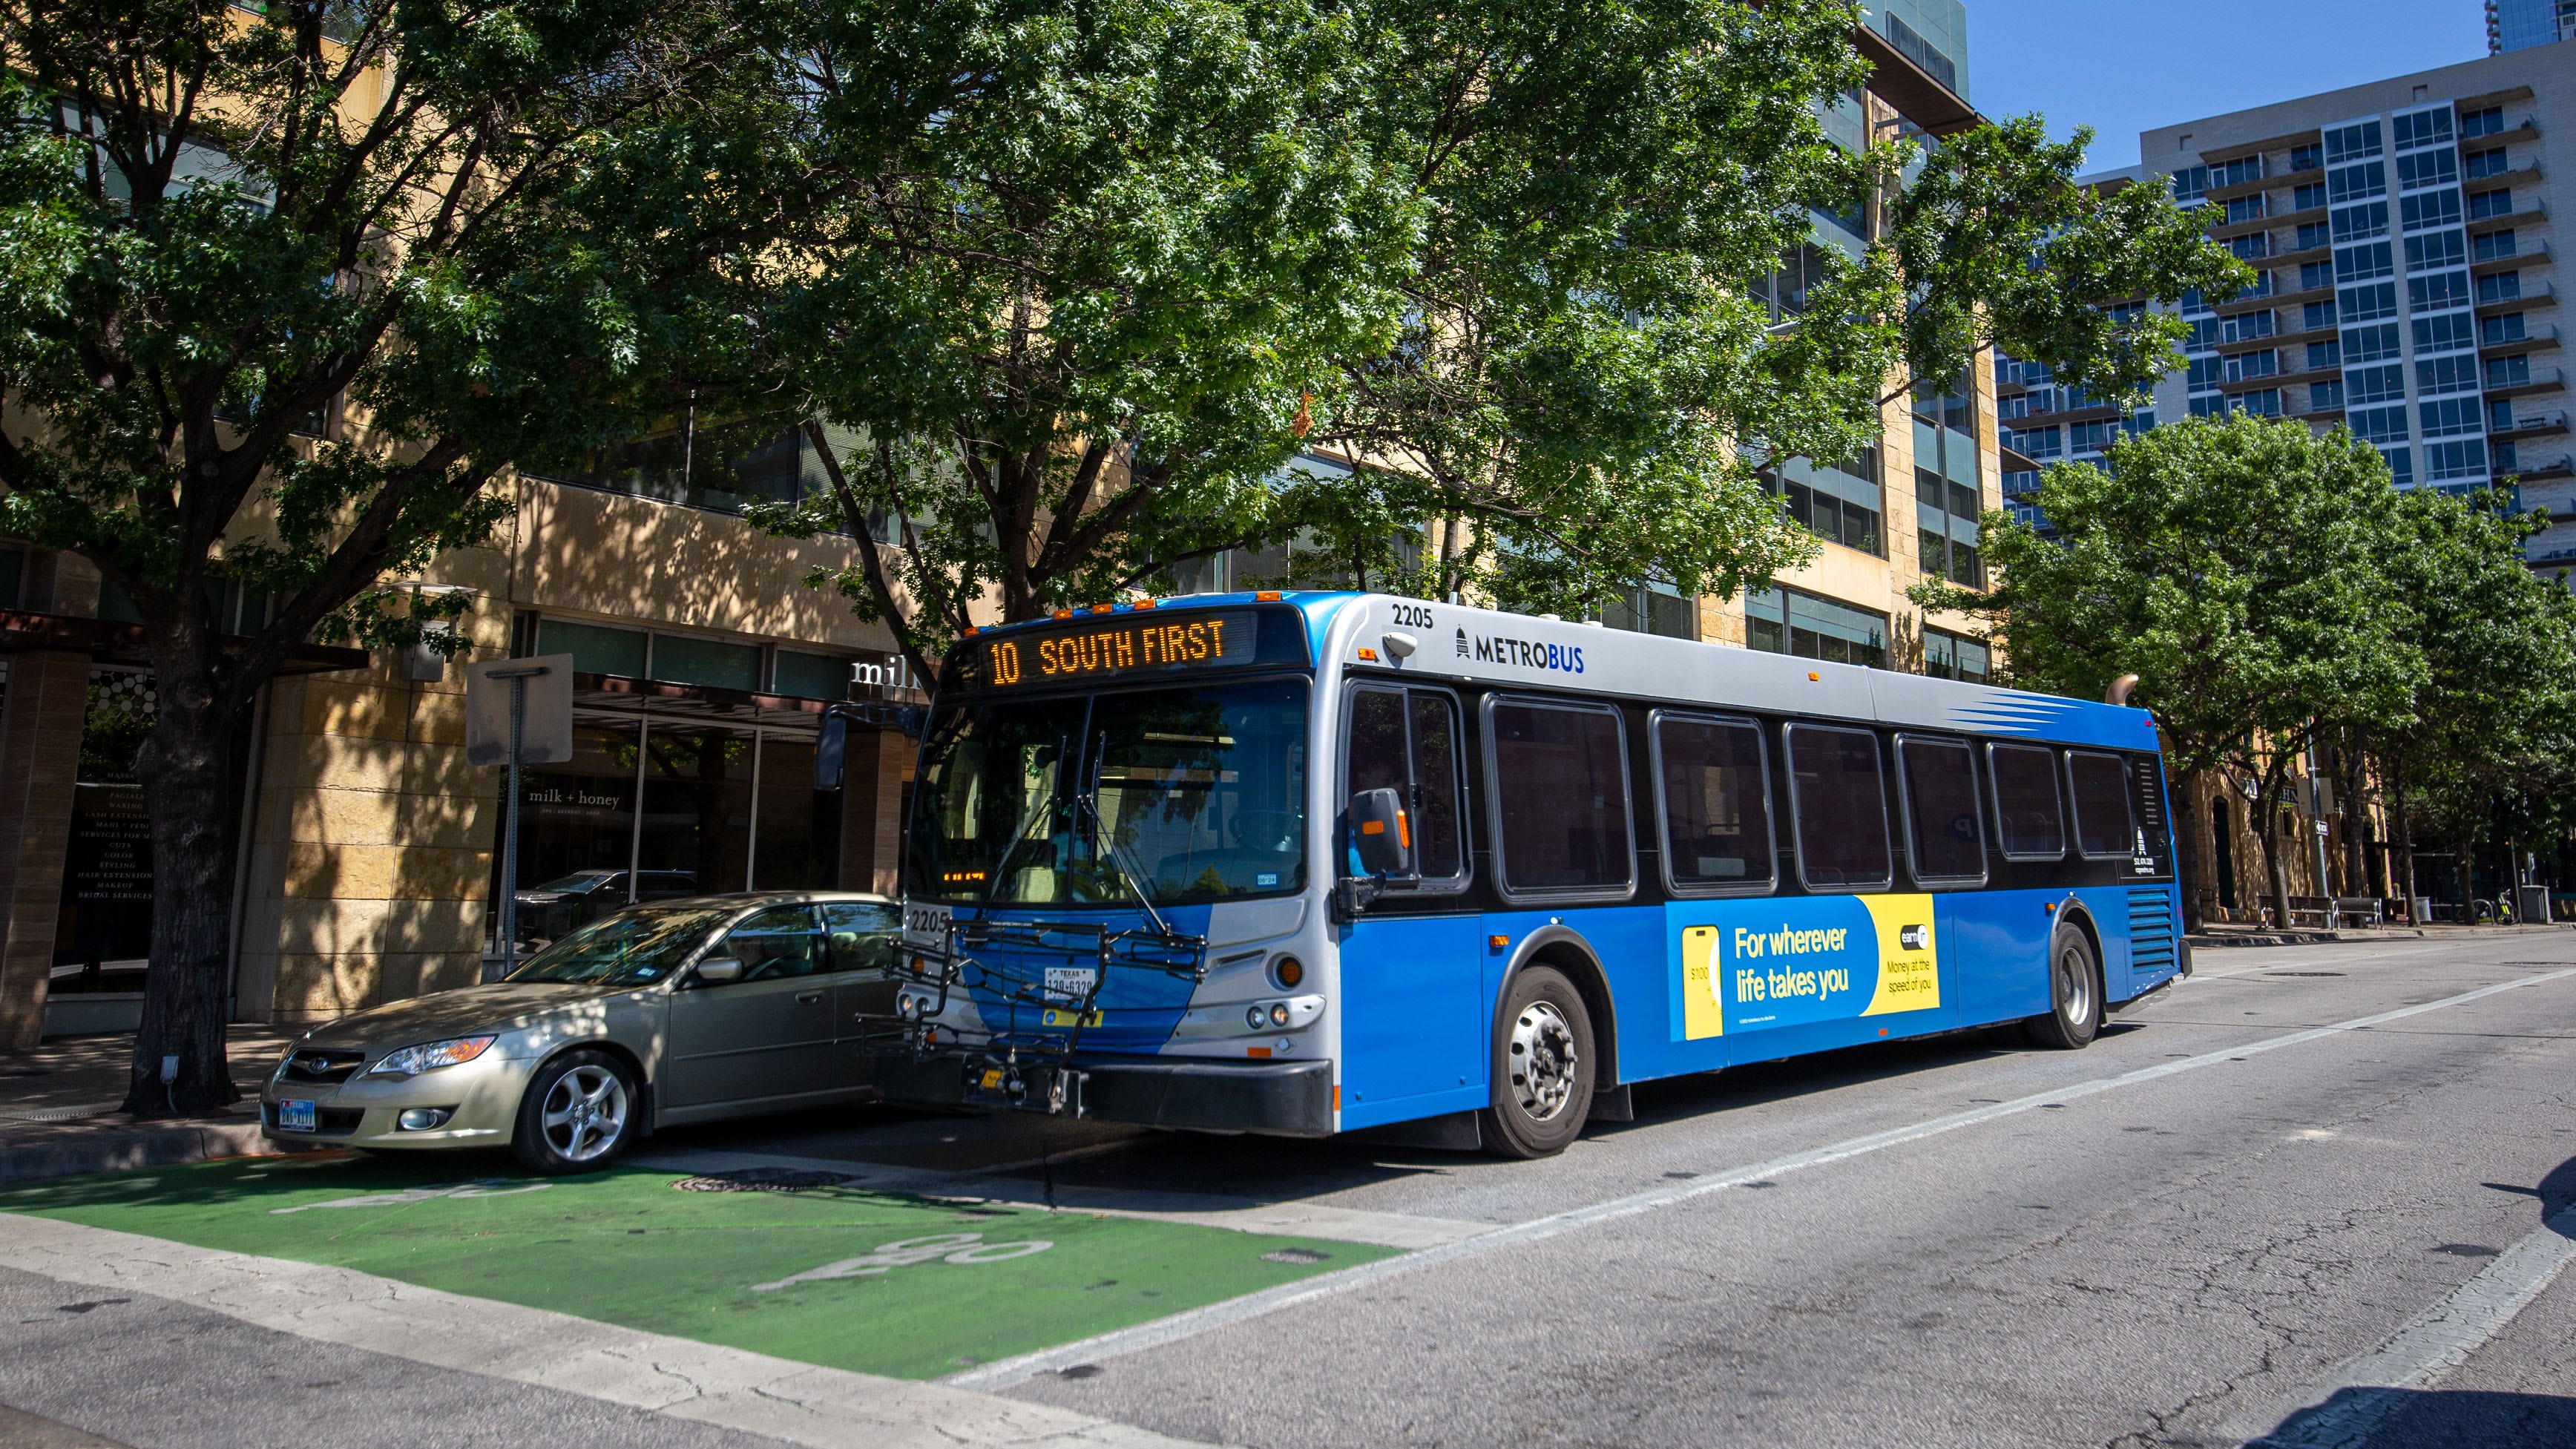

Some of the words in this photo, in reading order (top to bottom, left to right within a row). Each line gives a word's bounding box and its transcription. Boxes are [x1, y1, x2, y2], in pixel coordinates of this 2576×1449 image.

[1392, 603, 1433, 629] 2205
[990, 643, 1019, 685] 10
[1039, 631, 1134, 674] SOUTH
[1143, 620, 1223, 663] FIRST
[1476, 634, 1584, 674] METROBUS
[529, 789, 562, 802] milk
[578, 790, 620, 810] honey
[911, 909, 947, 934] 2205
[1735, 927, 1767, 959] For
[1769, 923, 1847, 956] wherever
[1887, 960, 1910, 975] Money
[1911, 959, 1918, 971] at
[1919, 958, 1930, 970] the
[1736, 968, 1766, 1003] life
[1767, 965, 1817, 999] takes
[1818, 968, 1849, 1002] you
[1889, 978, 1910, 996] speed
[1911, 976, 1918, 990] of
[1919, 979, 1931, 993] you
